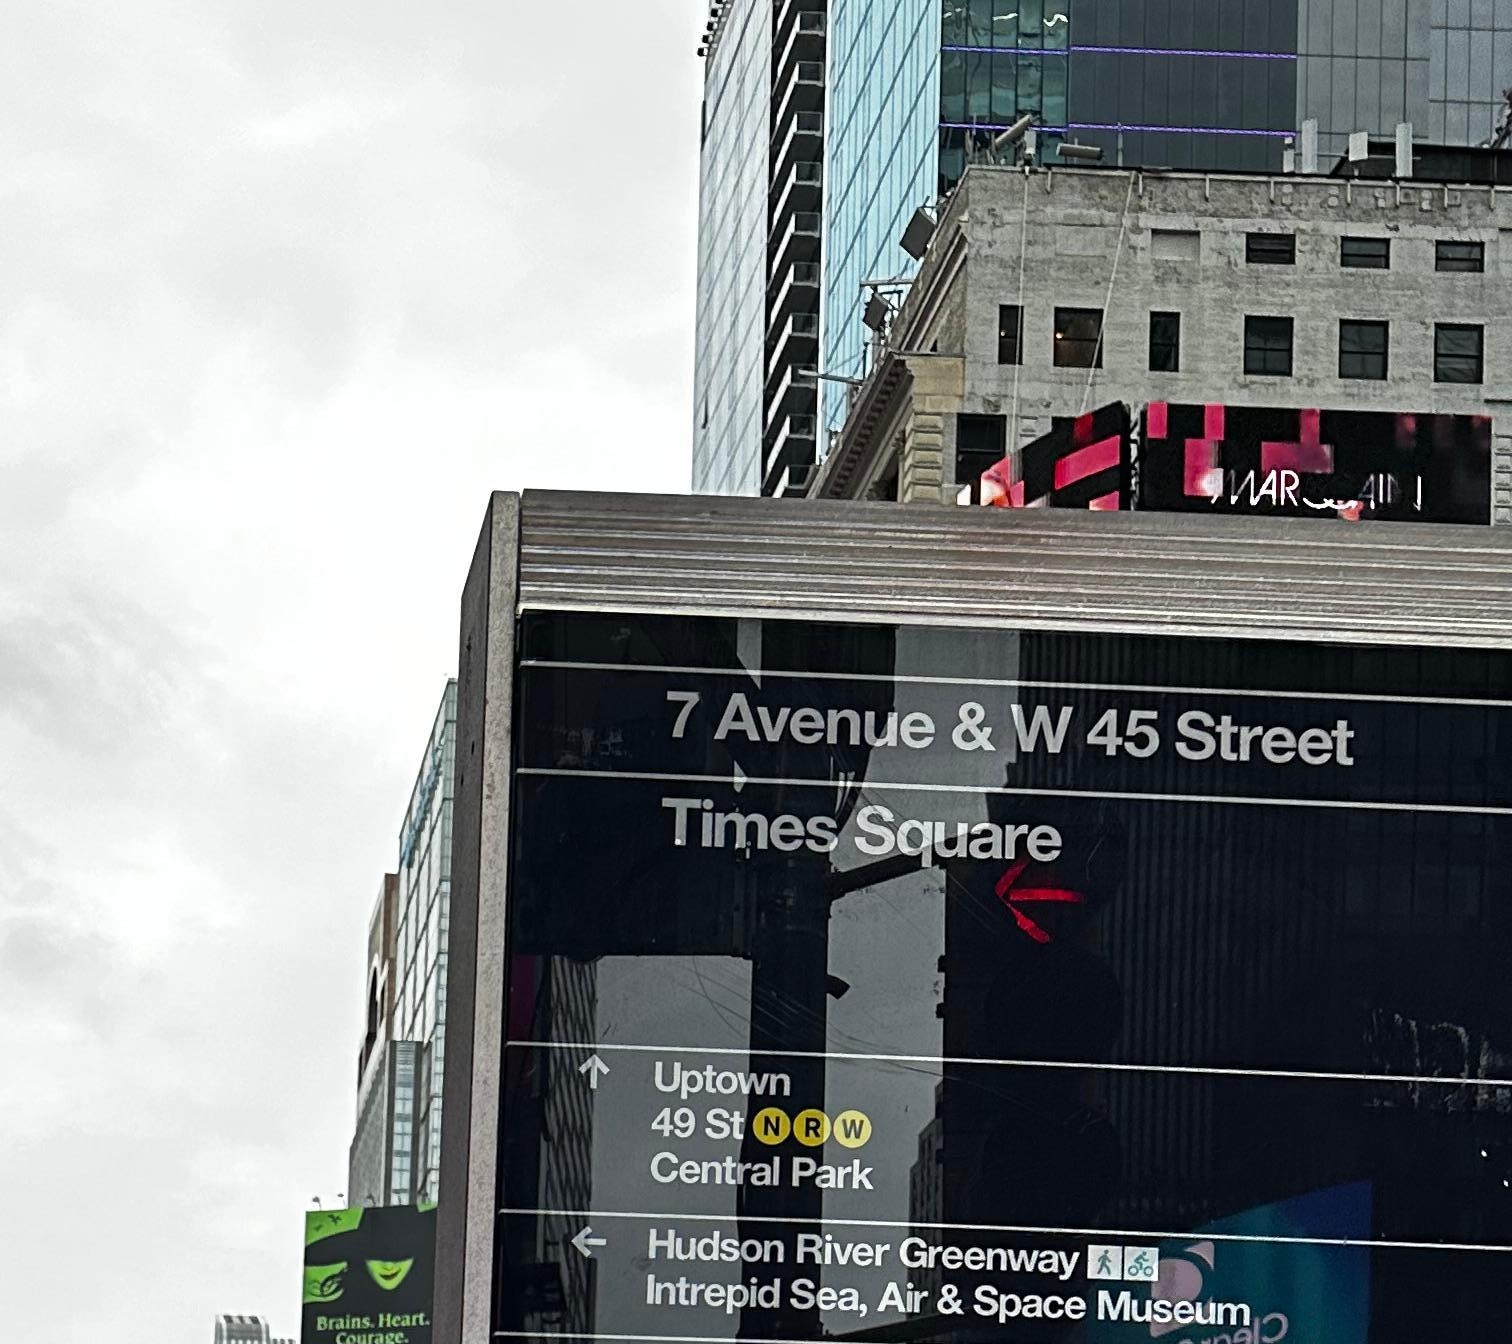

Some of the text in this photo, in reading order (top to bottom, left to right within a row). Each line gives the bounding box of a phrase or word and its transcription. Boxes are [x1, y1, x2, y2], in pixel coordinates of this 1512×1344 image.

[666, 690, 1354, 767] 7 Avenue & W 45 Street
[662, 797, 1064, 868] Times Square
[654, 1061, 791, 1099] Uptown
[651, 1107, 696, 1138] 49
[704, 1108, 744, 1139] St
[650, 1151, 874, 1190] Central Park
[648, 1228, 1080, 1281] Hudson River Greenway
[316, 1312, 431, 1332] Brains. Heart.
[645, 1273, 1251, 1327] Intrepid Sea, Air & Space Museum
